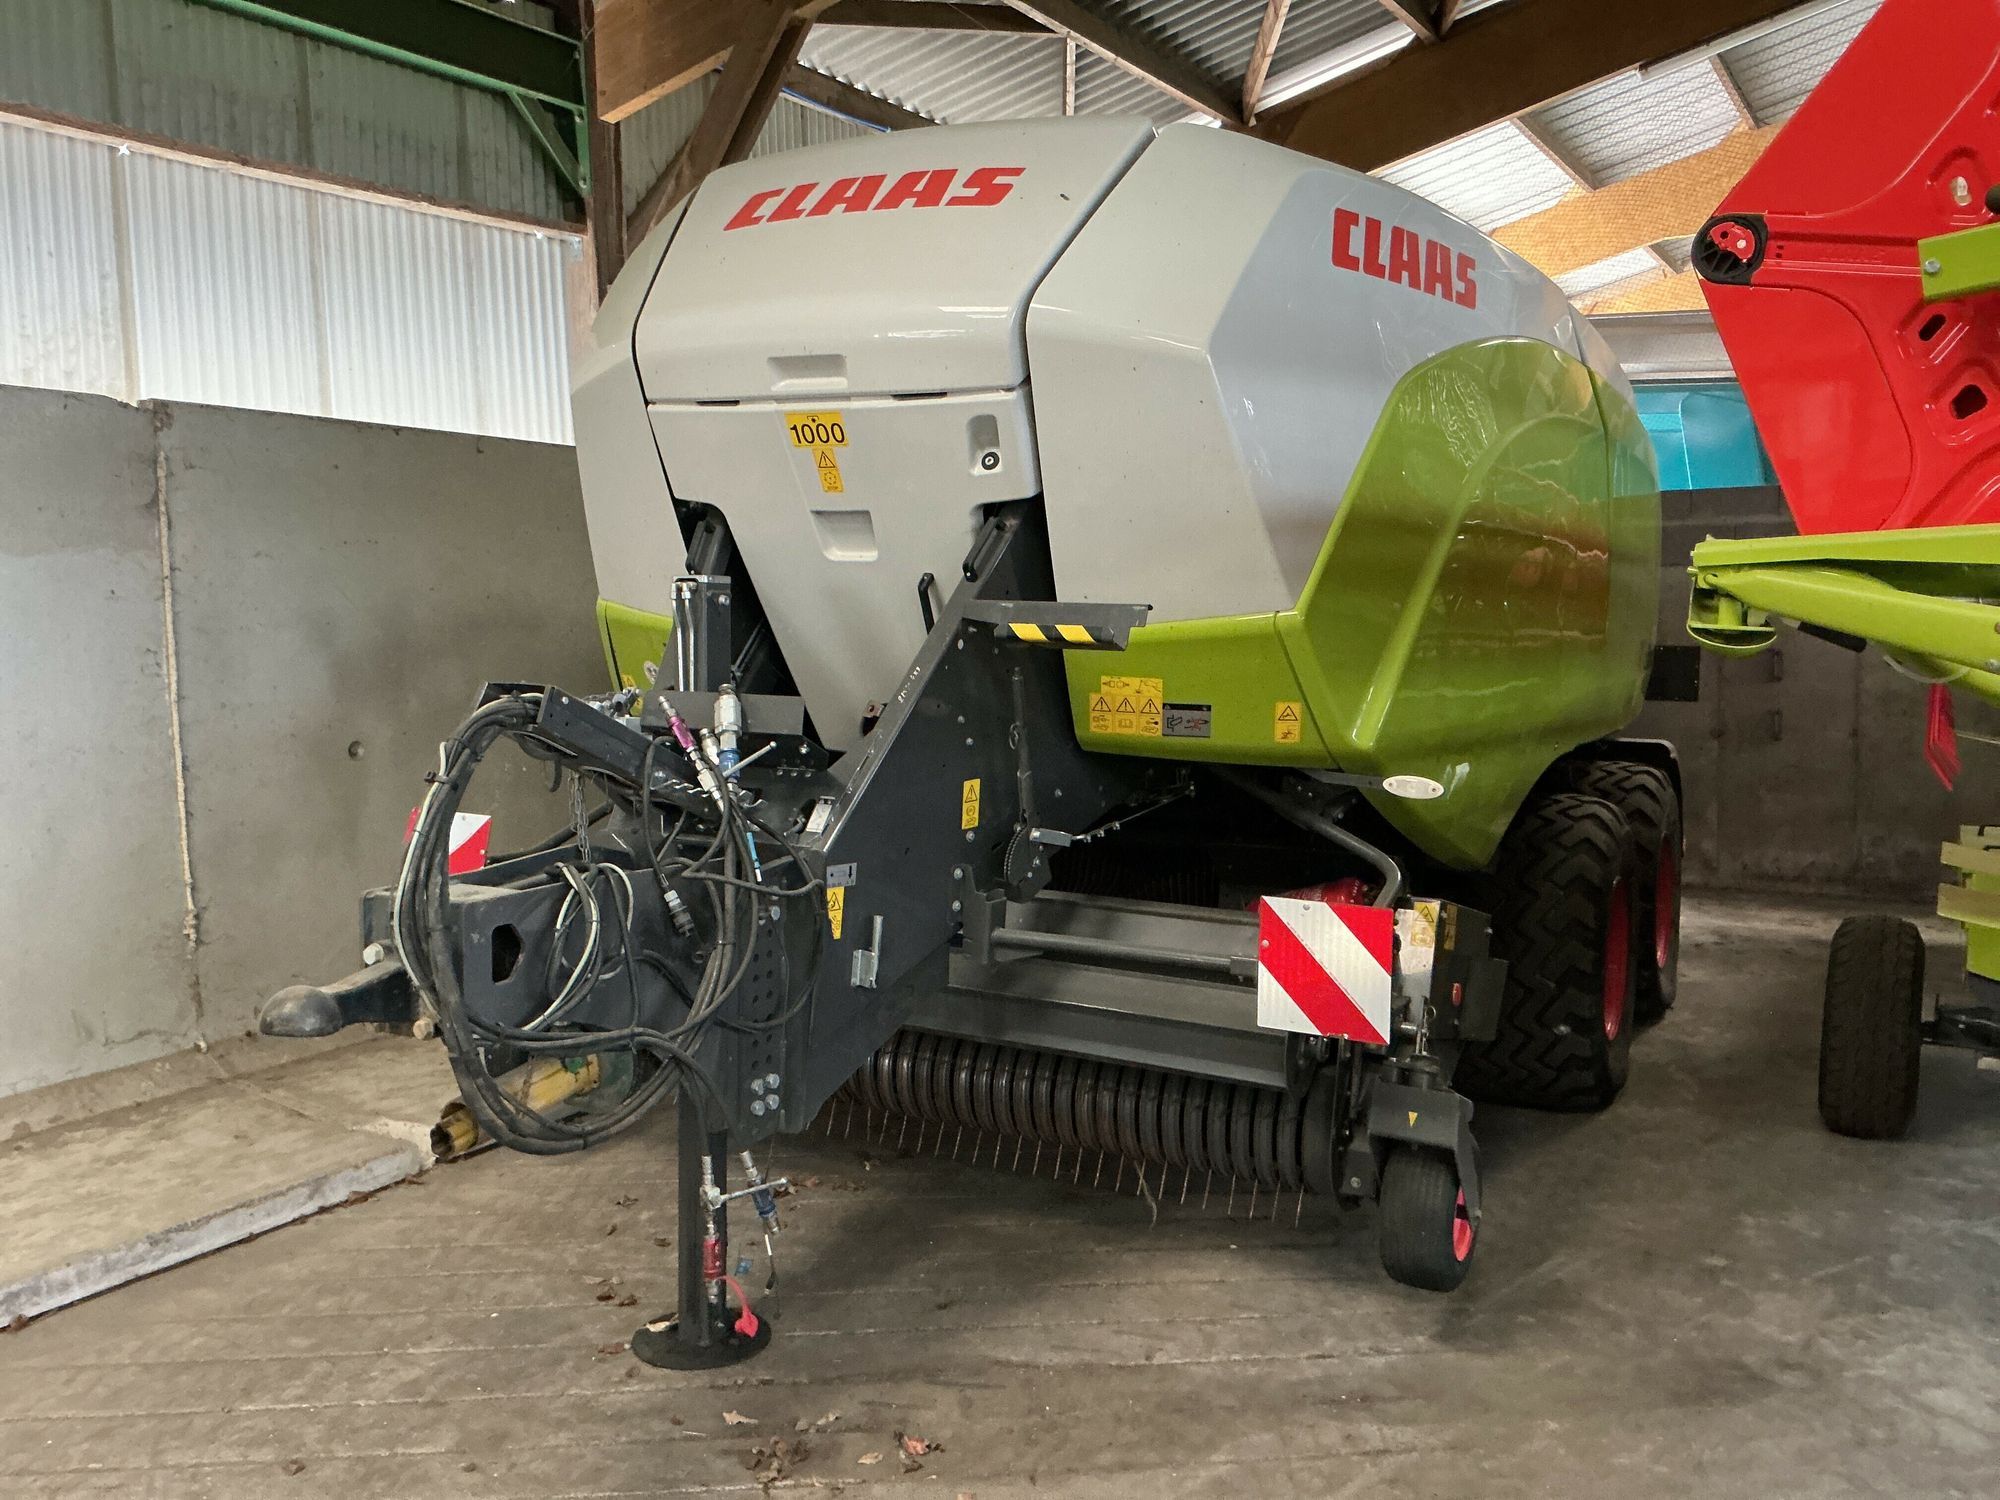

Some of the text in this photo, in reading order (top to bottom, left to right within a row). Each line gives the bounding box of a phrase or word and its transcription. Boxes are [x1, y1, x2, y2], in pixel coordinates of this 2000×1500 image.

[723, 167, 1027, 231] CLAAS
[1331, 207, 1477, 311] CLAAS
[789, 422, 845, 444] 1000
